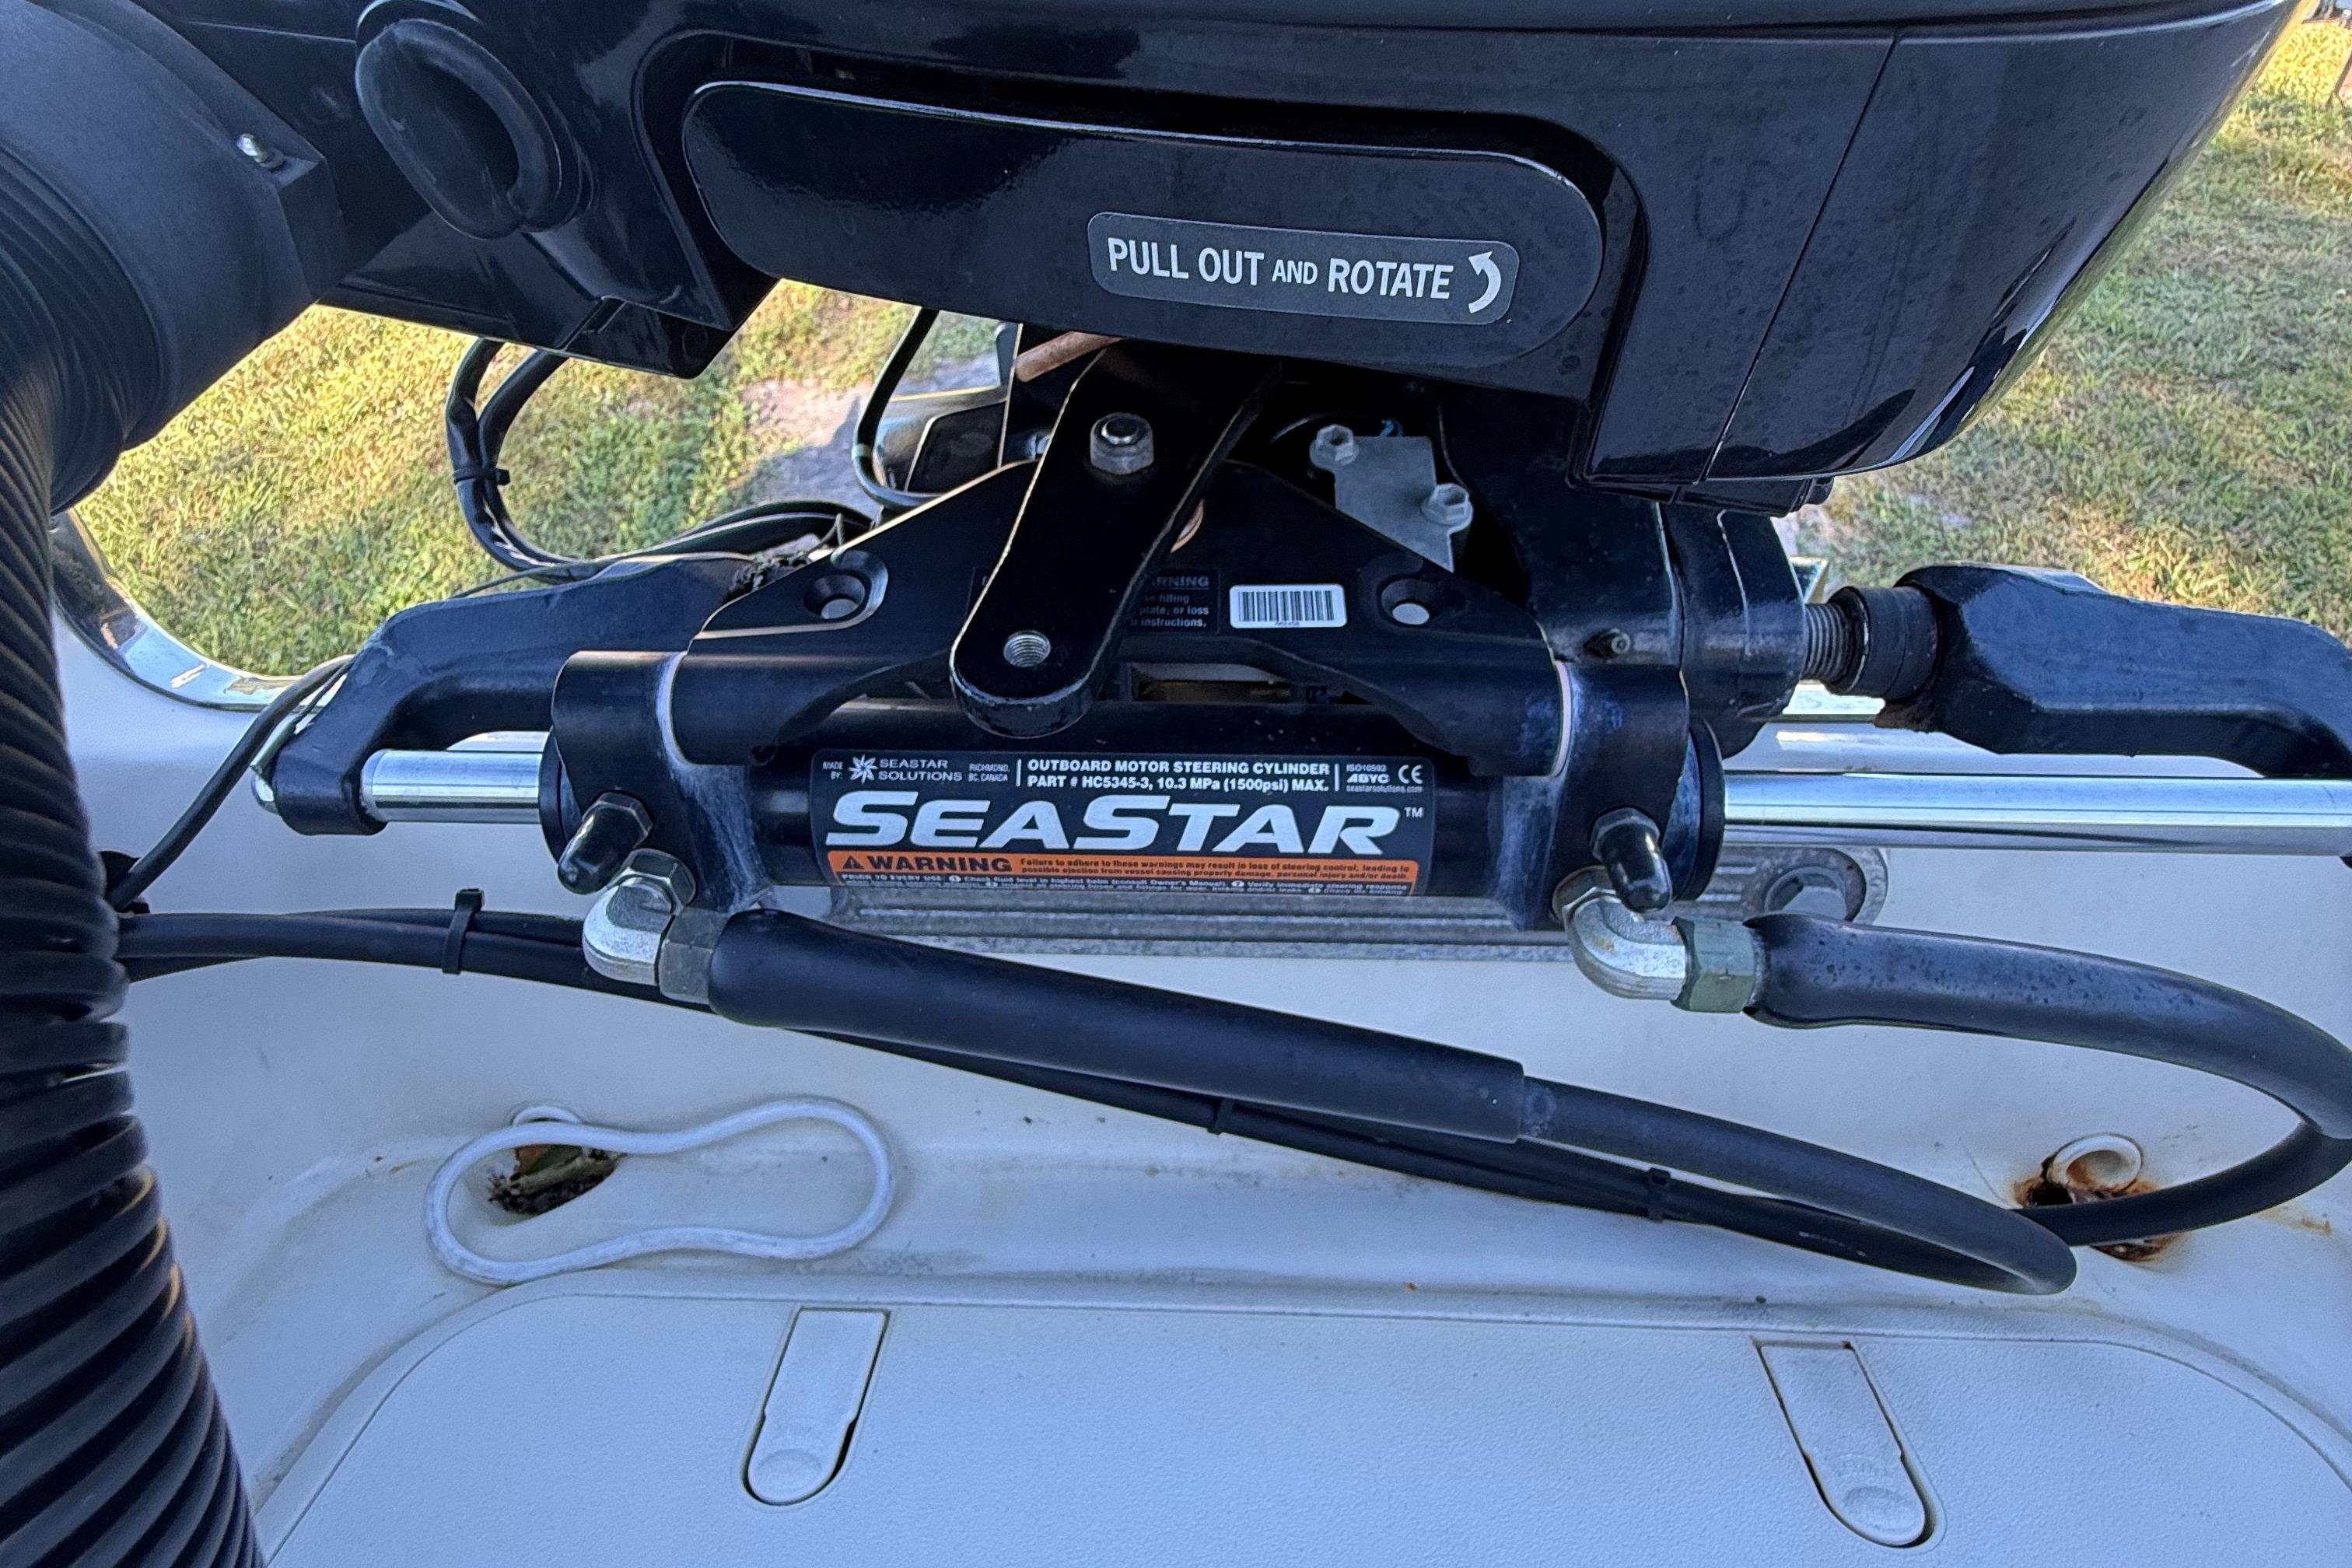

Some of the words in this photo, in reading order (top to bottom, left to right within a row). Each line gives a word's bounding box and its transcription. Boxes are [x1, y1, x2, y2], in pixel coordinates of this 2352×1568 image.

[1107, 236, 1189, 279] PULL
[1198, 247, 1265, 286] OUT
[1272, 259, 1318, 285] AND
[1327, 257, 1454, 300] ROTATE
[1187, 605, 1210, 615] loss
[1140, 618, 1208, 628] instructions.
[822, 761, 844, 770] MADE
[879, 758, 949, 769] SEASTAR
[1027, 758, 1112, 772] OUTBOARD
[1115, 760, 1170, 773] MOTOR
[1173, 761, 1250, 775] STEERING
[1252, 762, 1330, 775] CYLINDER
[878, 771, 963, 782] SOLUTIONS
[980, 773, 1009, 782] CANADA
[1346, 773, 1390, 784] ABYC
[1027, 775, 1067, 788] PART
[1070, 775, 1079, 788] #
[1081, 775, 1153, 791] HC5345-3,
[1157, 776, 1187, 789] 10.3
[1189, 777, 1220, 790] MPa
[1223, 777, 1289, 793] (1500psi)
[1292, 779, 1329, 792] MAX.
[825, 789, 1402, 855] SEASTAR
[866, 855, 1013, 873] WARNING
[1067, 859, 1100, 867] adhere
[1140, 860, 1184, 870] warnings
[1208, 861, 1235, 870] result
[1282, 863, 1321, 872] steering
[1363, 864, 1398, 873] leading
[1156, 869, 1192, 877] causing
[1276, 870, 1318, 879] personal
